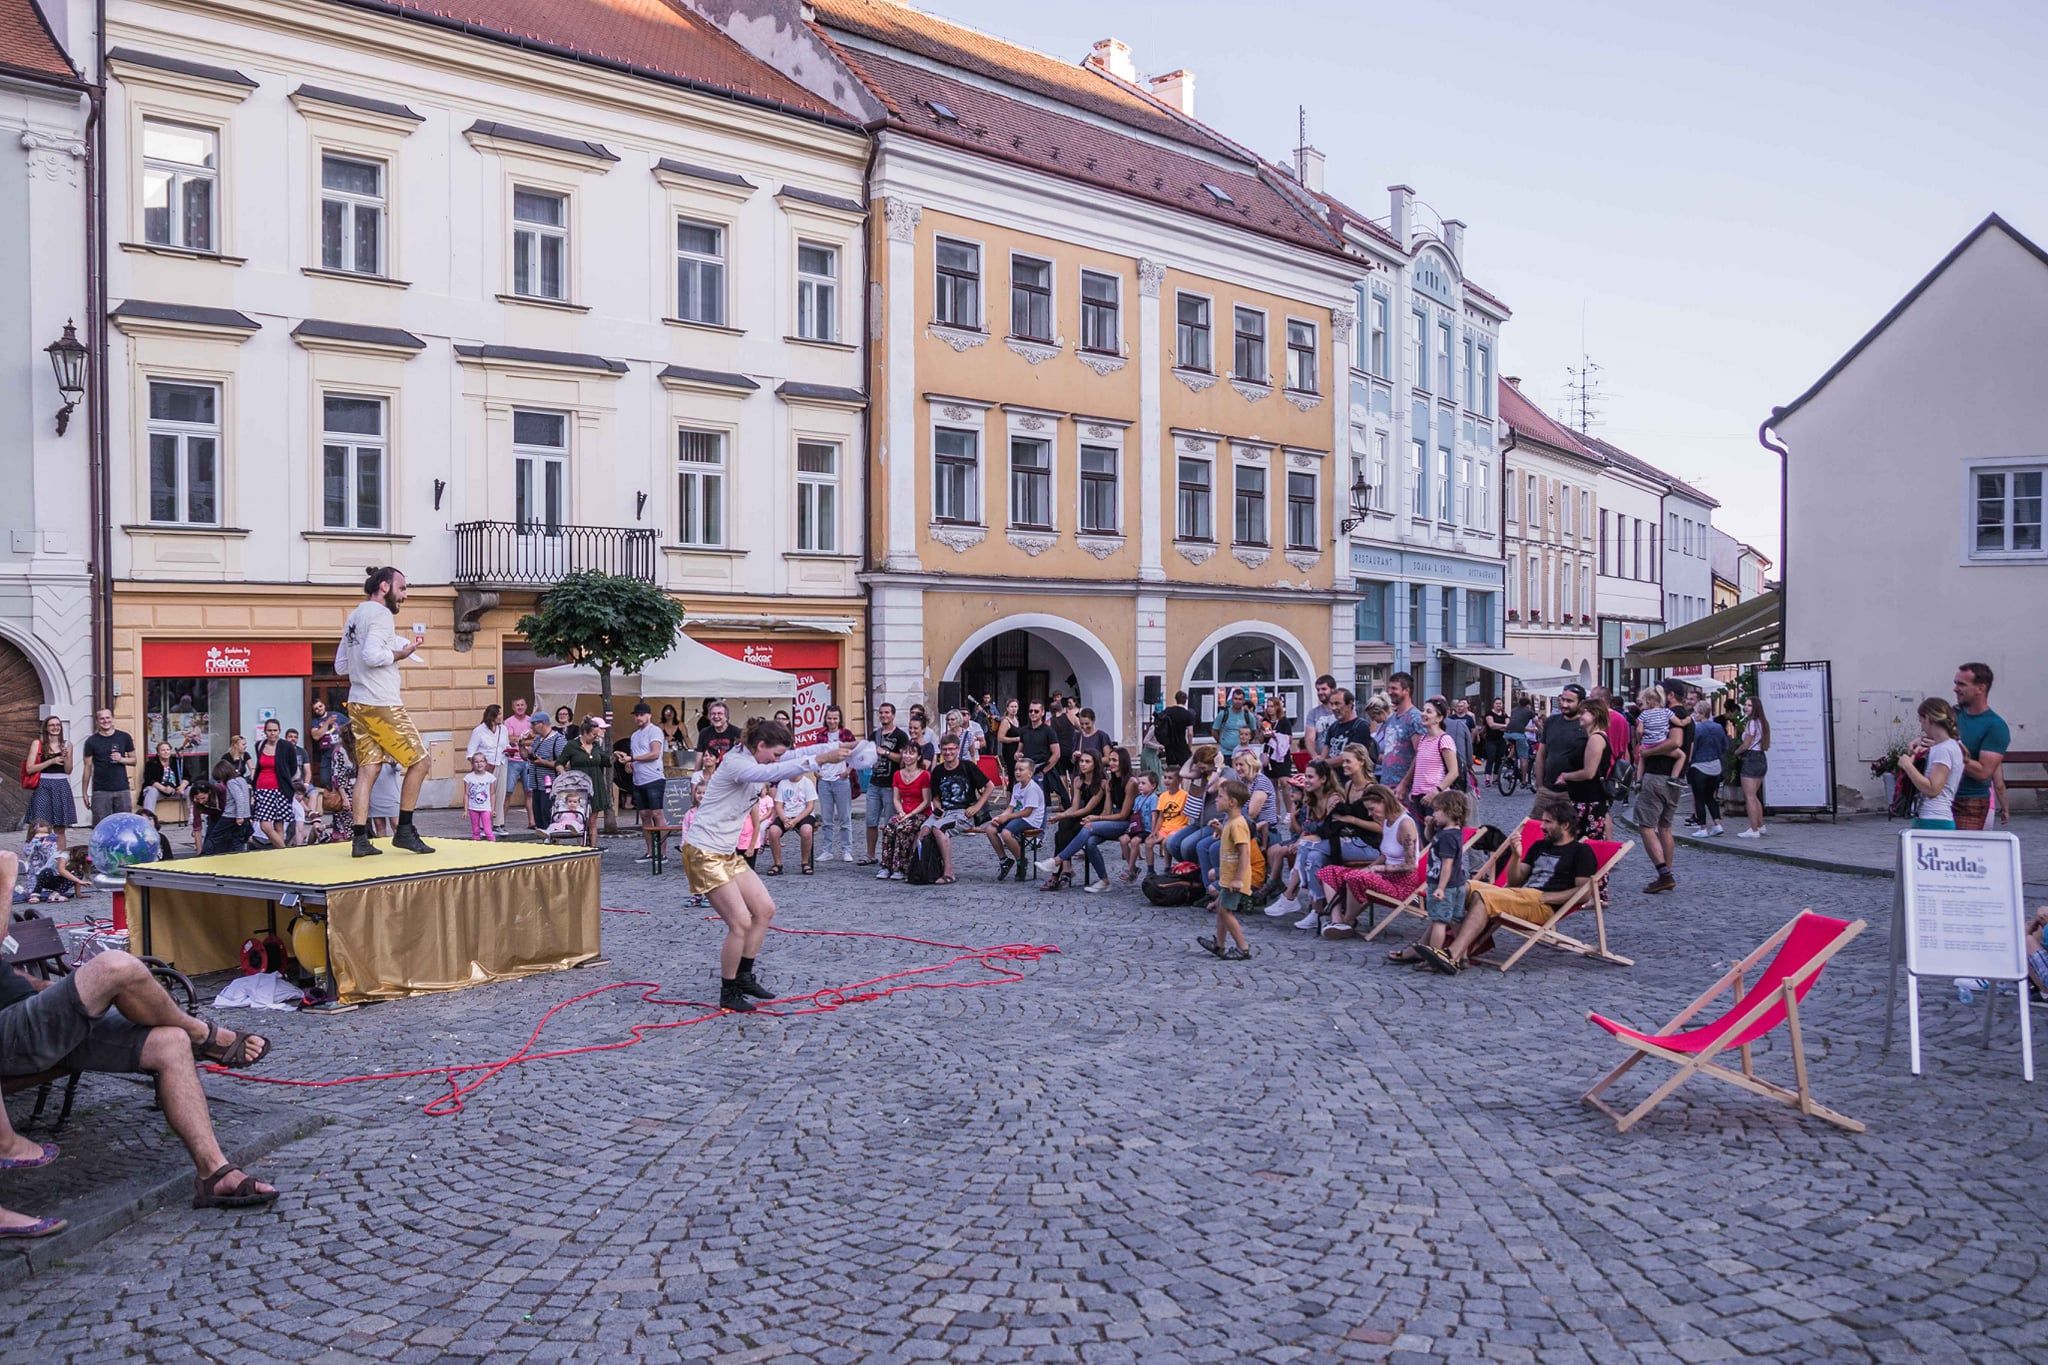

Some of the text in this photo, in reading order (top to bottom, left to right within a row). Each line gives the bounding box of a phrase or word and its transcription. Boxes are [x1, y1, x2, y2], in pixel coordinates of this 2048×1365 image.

[1354, 554, 1393, 567] RESTAURANT
[206, 656, 249, 668] rieker
[743, 653, 772, 663] rieker
[797, 676, 814, 685] LEVA
[1917, 842, 1939, 859] La
[1917, 857, 1977, 872] Strada
